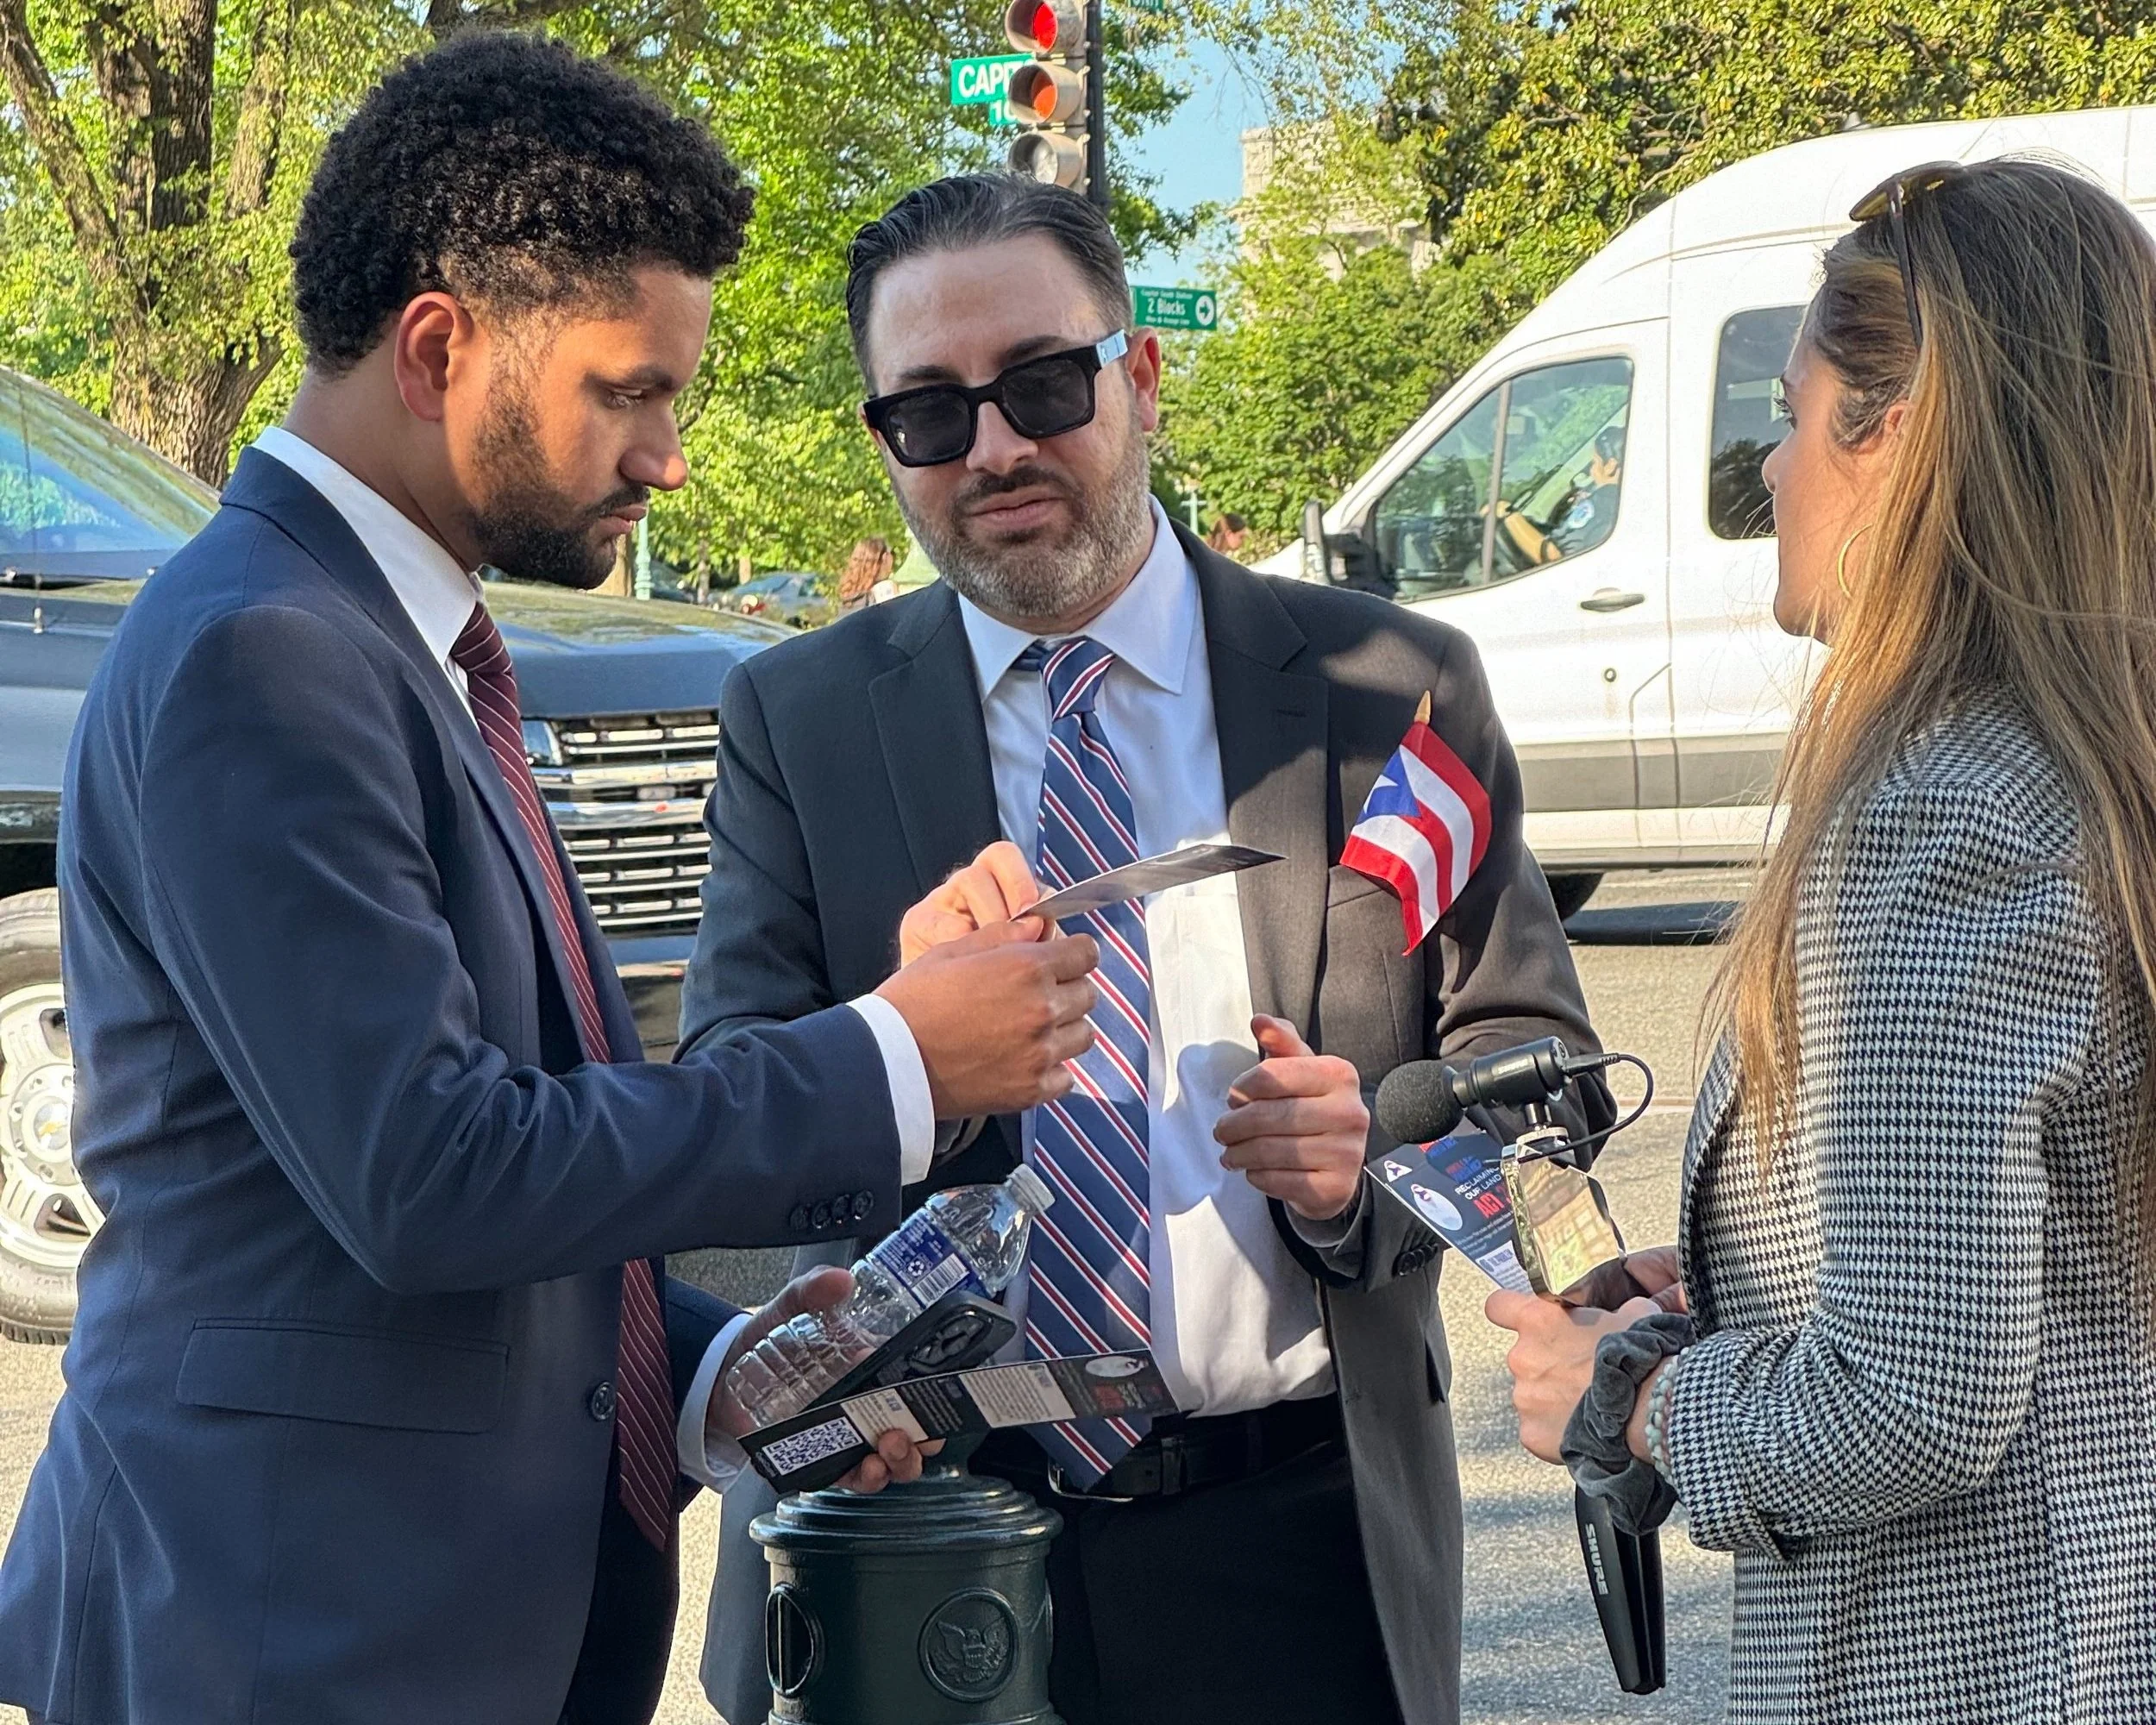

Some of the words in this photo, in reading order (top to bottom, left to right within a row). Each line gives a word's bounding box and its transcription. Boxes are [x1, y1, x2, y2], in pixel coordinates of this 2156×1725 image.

[958, 59, 1037, 97] CAPIT
[1147, 298, 1155, 314] 2
[1157, 298, 1186, 316] Blocks
[1464, 1186, 1483, 1200] OUR
[1481, 1174, 1502, 1190] LAND
[1584, 1522, 1608, 1596] SHURE
